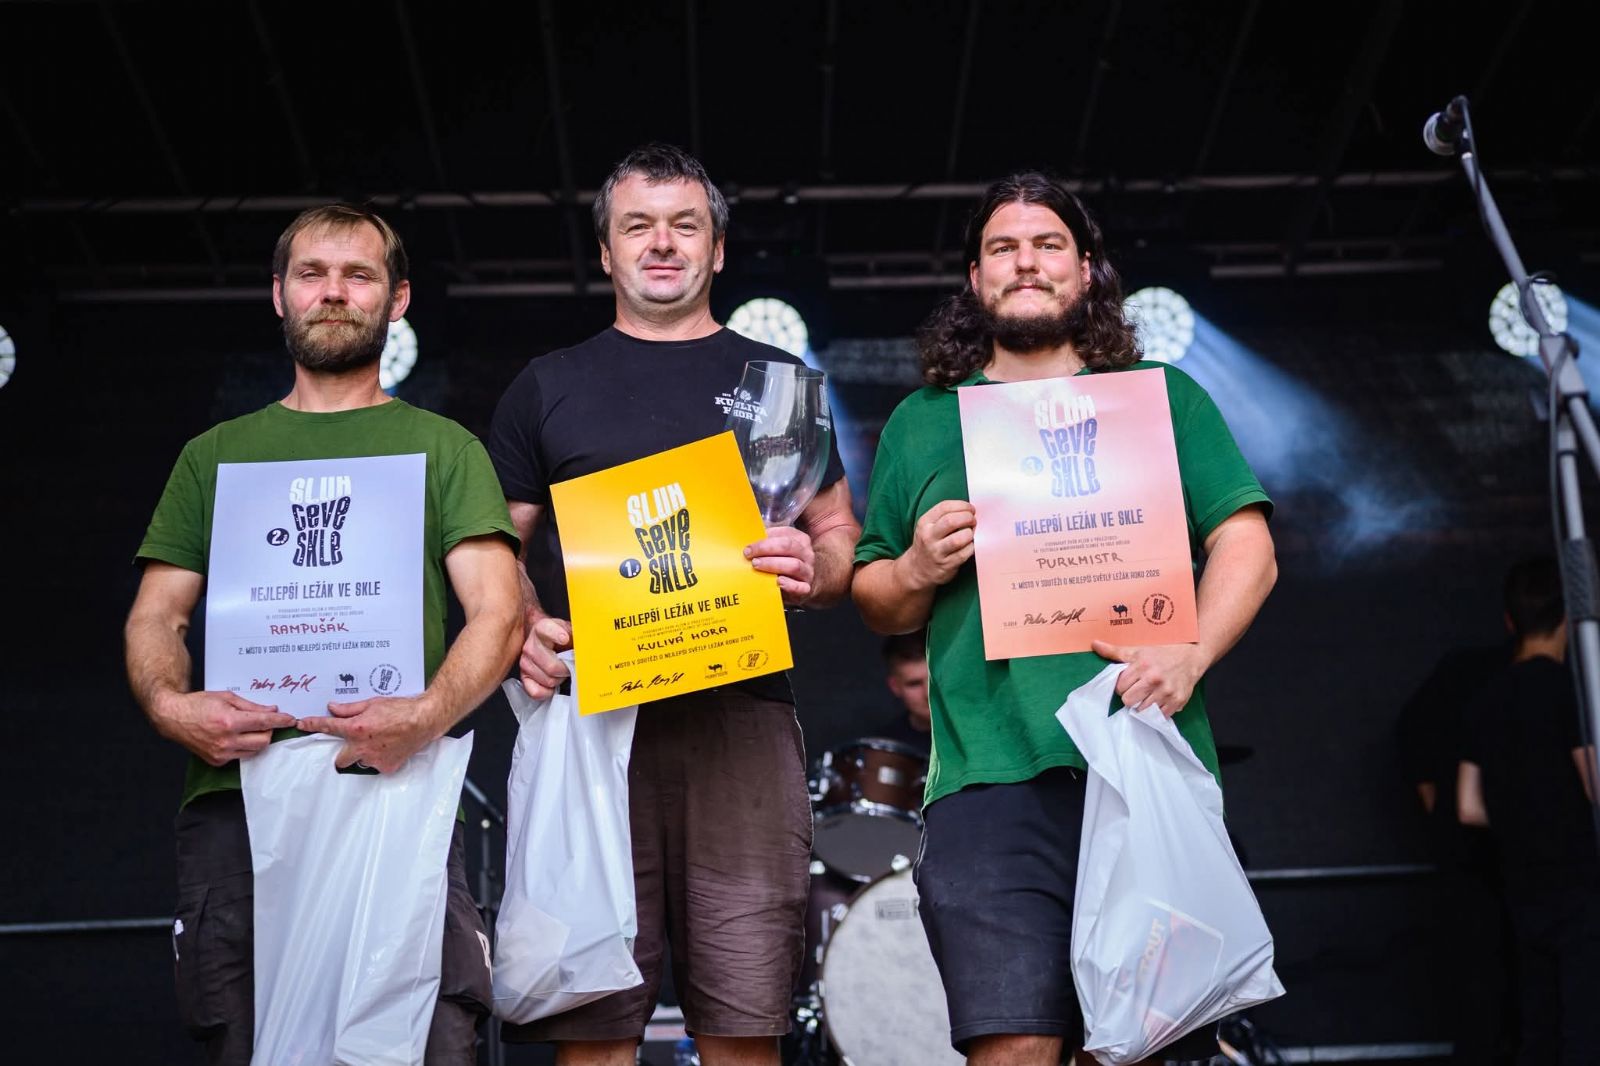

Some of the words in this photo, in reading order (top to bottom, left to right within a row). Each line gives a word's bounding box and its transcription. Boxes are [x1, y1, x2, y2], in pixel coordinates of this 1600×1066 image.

[289, 475, 352, 503] SLUN
[626, 482, 687, 528] SLUN
[1015, 513, 1062, 536] NEJLEPŠÍ
[1066, 510, 1098, 530] LEŽÁK
[1100, 512, 1114, 527] VE
[1118, 508, 1144, 526] SKLE
[1036, 552, 1124, 570] PURKMISTR
[1130, 570, 1144, 579] ROKU
[250, 582, 298, 602] NEJLEPŠÍ
[303, 580, 334, 599] LEŽÁK
[338, 582, 351, 598] VE
[355, 581, 381, 596] SKLE
[614, 608, 660, 630] NEJLEPŠÍ
[664, 602, 694, 620] LEŽÁK
[698, 599, 710, 612] VE
[715, 594, 740, 609] SKLE
[270, 617, 350, 635] RAMPUŠÁK
[360, 640, 375, 649] ROKU
[637, 632, 684, 652] KULIVÁ
[691, 626, 728, 640] HORA
[725, 638, 740, 646] ROKU
